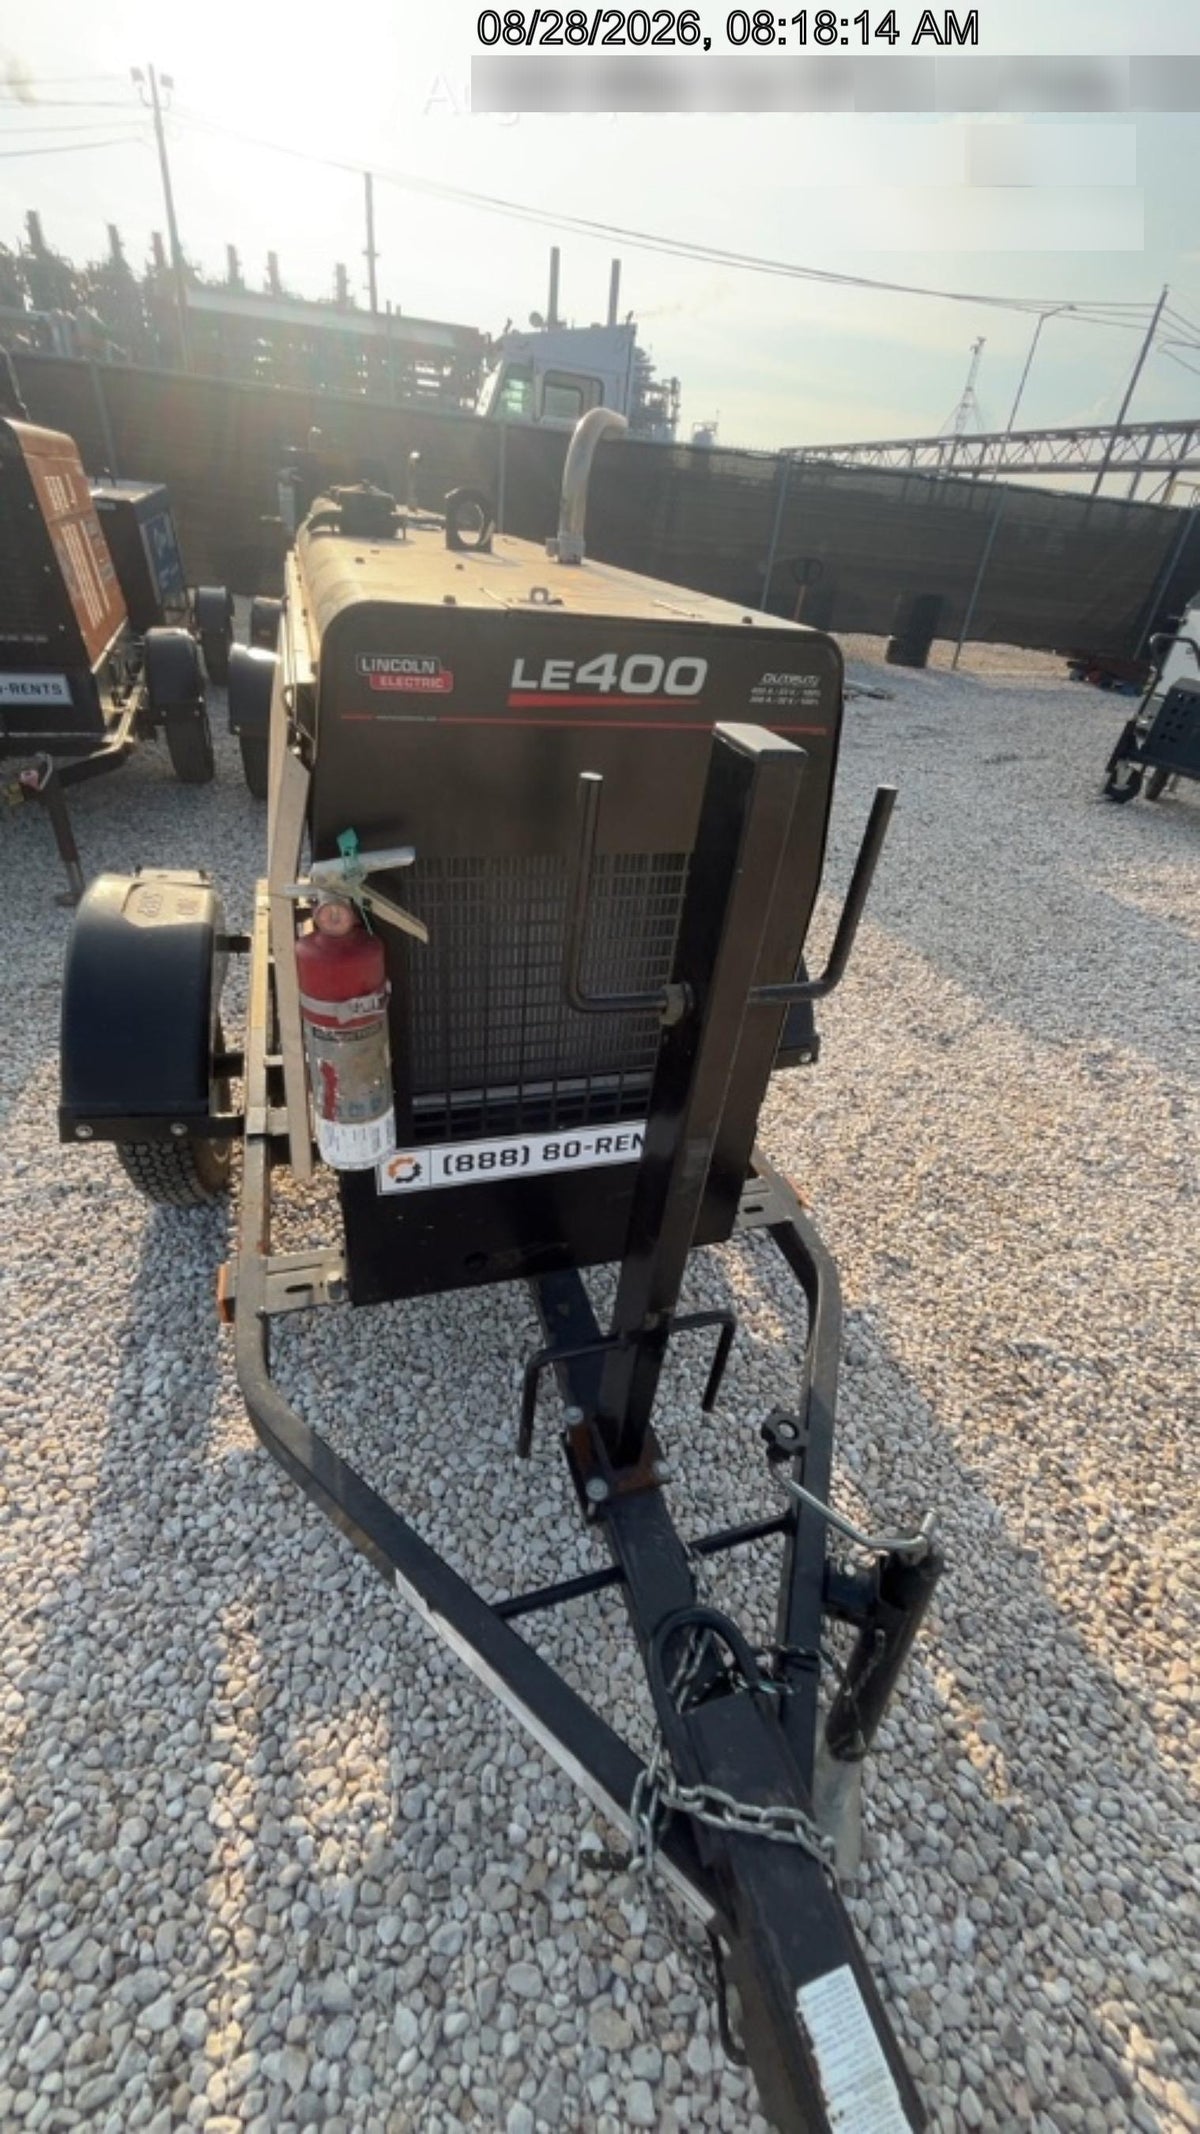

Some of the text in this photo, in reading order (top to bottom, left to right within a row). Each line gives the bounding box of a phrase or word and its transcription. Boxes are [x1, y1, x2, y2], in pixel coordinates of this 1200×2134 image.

[360, 656, 436, 675] LINCOLN
[511, 653, 708, 695] LE400
[379, 675, 445, 689] ELECTRIC
[443, 1144, 530, 1176] (888)
